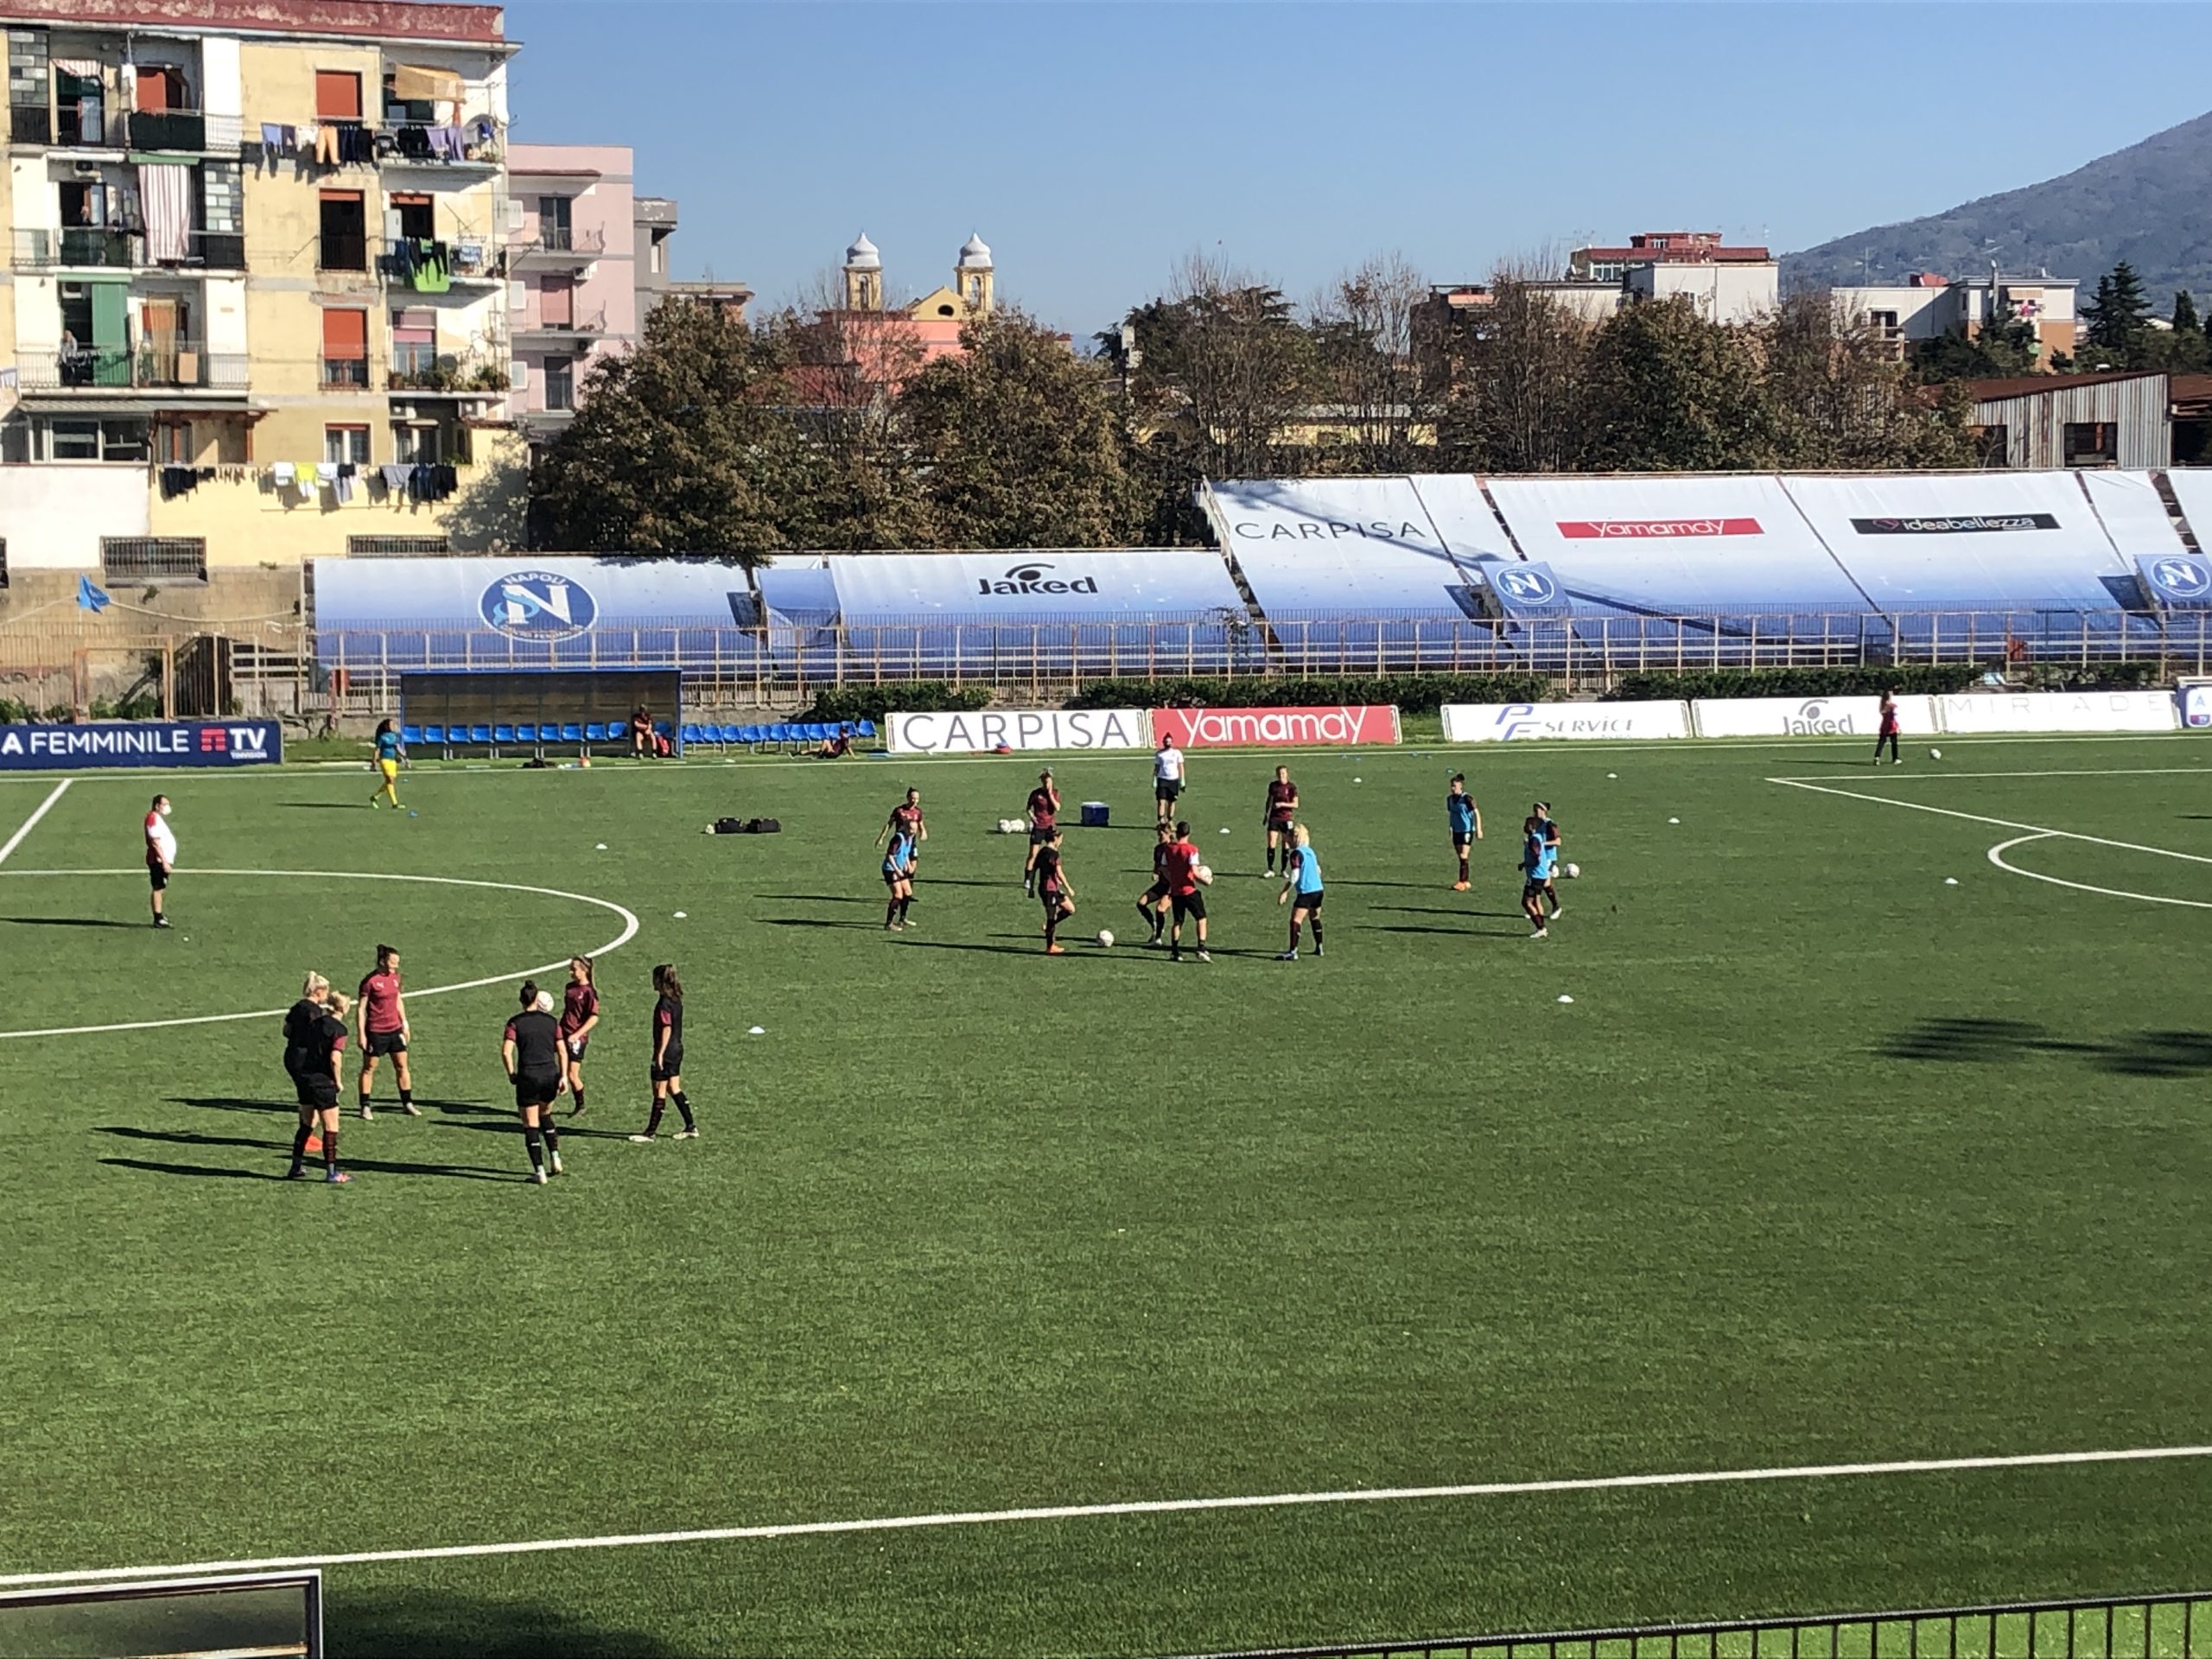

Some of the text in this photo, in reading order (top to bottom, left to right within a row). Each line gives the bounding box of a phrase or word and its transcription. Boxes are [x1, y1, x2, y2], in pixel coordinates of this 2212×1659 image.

[1235, 522, 1426, 539] CARPISA
[1902, 517, 2035, 531] ideabellezza
[504, 573, 567, 584] NAPOLI
[1948, 695, 2165, 715] MIRIADE
[229, 728, 266, 750] TV
[902, 712, 1131, 750] CARPISA
[0, 729, 190, 755] A FEMMINILE
